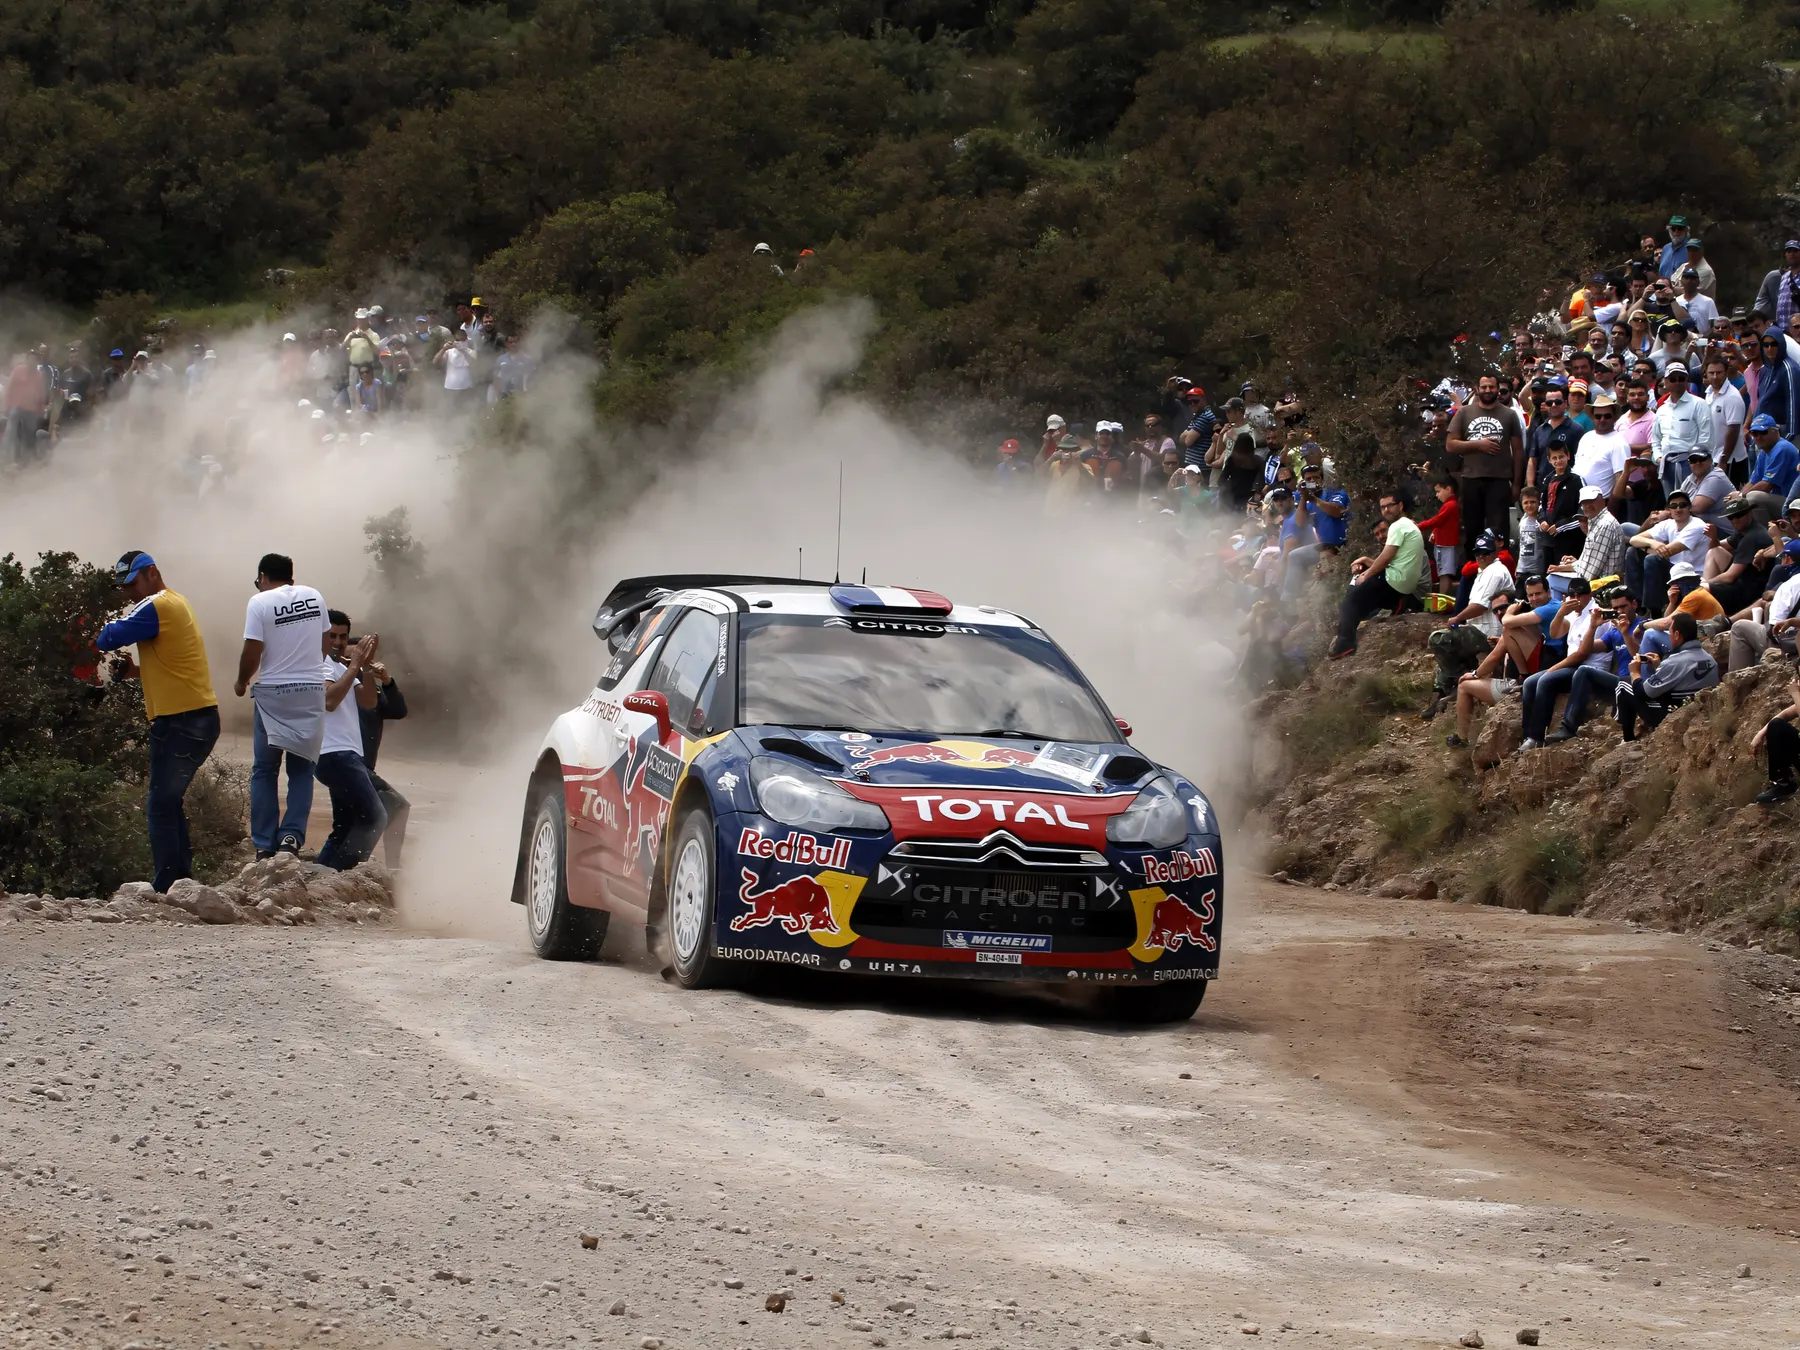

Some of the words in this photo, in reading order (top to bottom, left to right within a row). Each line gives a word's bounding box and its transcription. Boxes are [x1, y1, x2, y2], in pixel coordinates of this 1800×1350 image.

[274, 598, 319, 616] WRC
[857, 620, 980, 635] CITROËN
[628, 695, 659, 707] TOTAL
[580, 785, 618, 830] TOTAL
[901, 795, 1090, 830] TOTAL
[913, 884, 1086, 910] CITROËN
[970, 935, 1047, 947] MICHELIN
[717, 946, 820, 965] EURODATACAR
